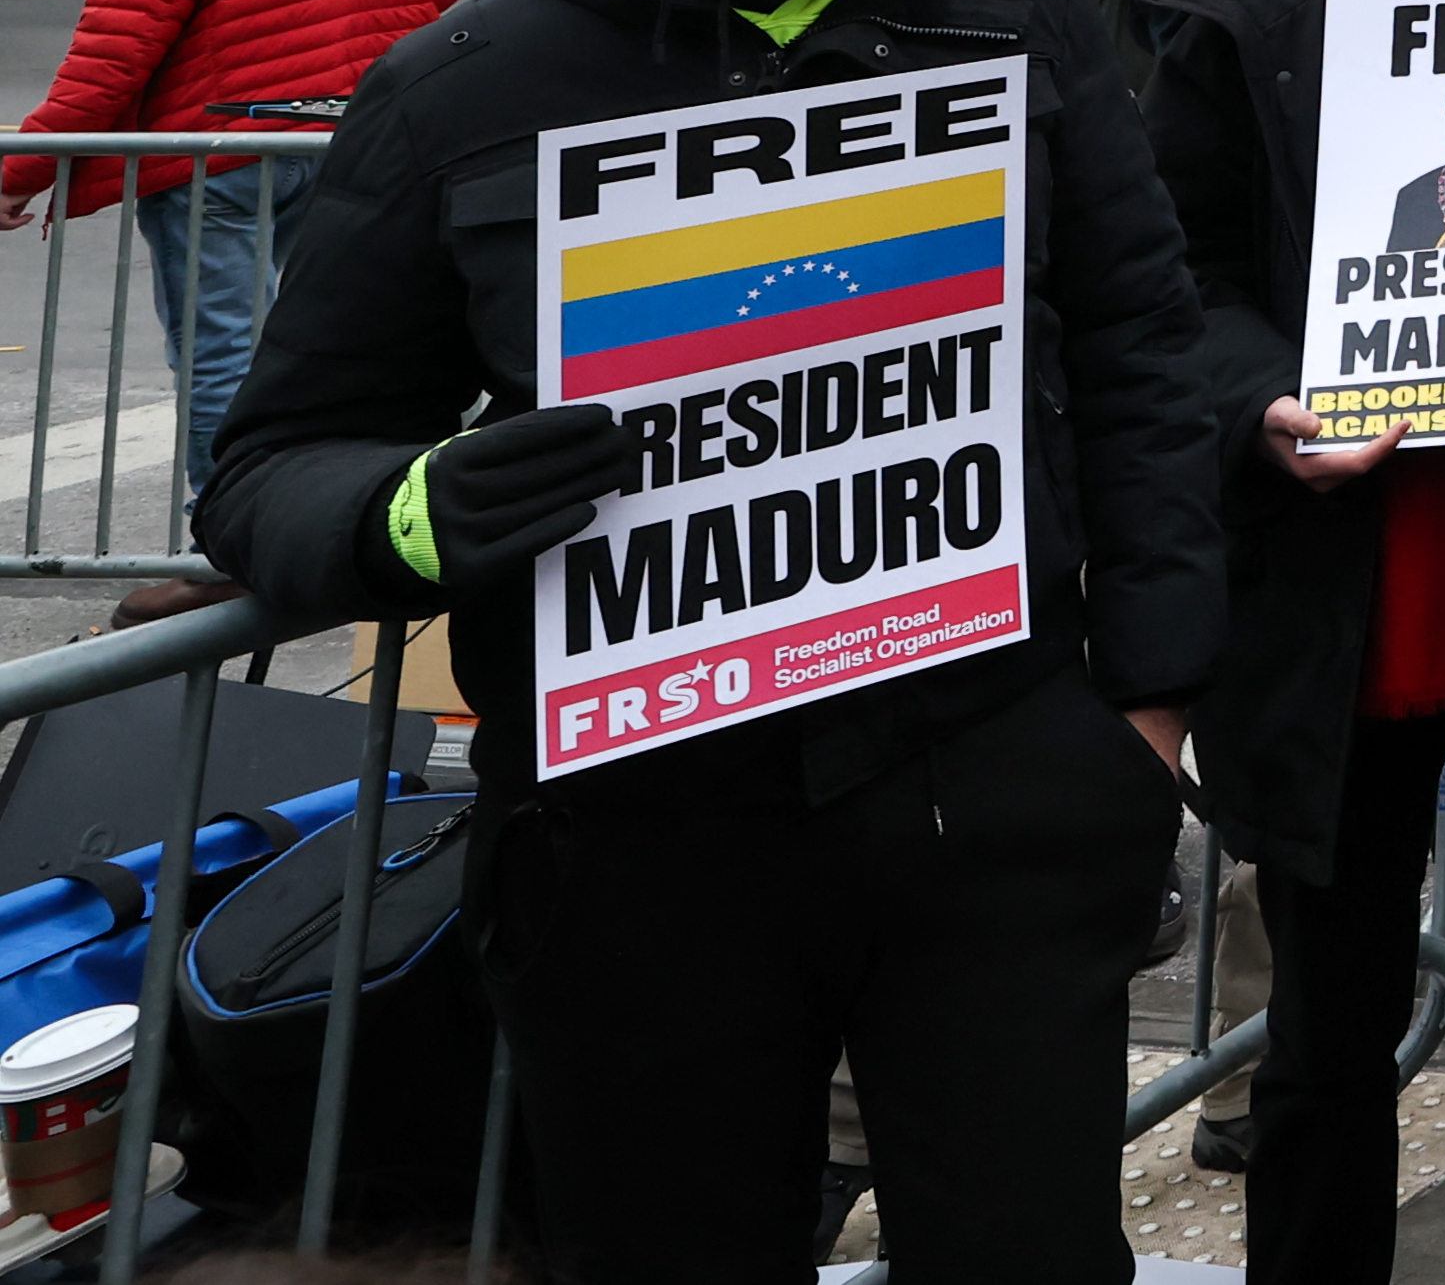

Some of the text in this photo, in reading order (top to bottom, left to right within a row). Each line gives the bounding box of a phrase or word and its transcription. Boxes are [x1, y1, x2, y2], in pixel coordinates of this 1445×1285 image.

[560, 77, 1010, 222] FREE
[612, 325, 1003, 498] RESIDENT
[565, 443, 1002, 656] MADURO
[774, 604, 941, 667] Freedom Road
[774, 608, 1015, 690] Socialist Organization
[559, 658, 750, 753] FRSO
